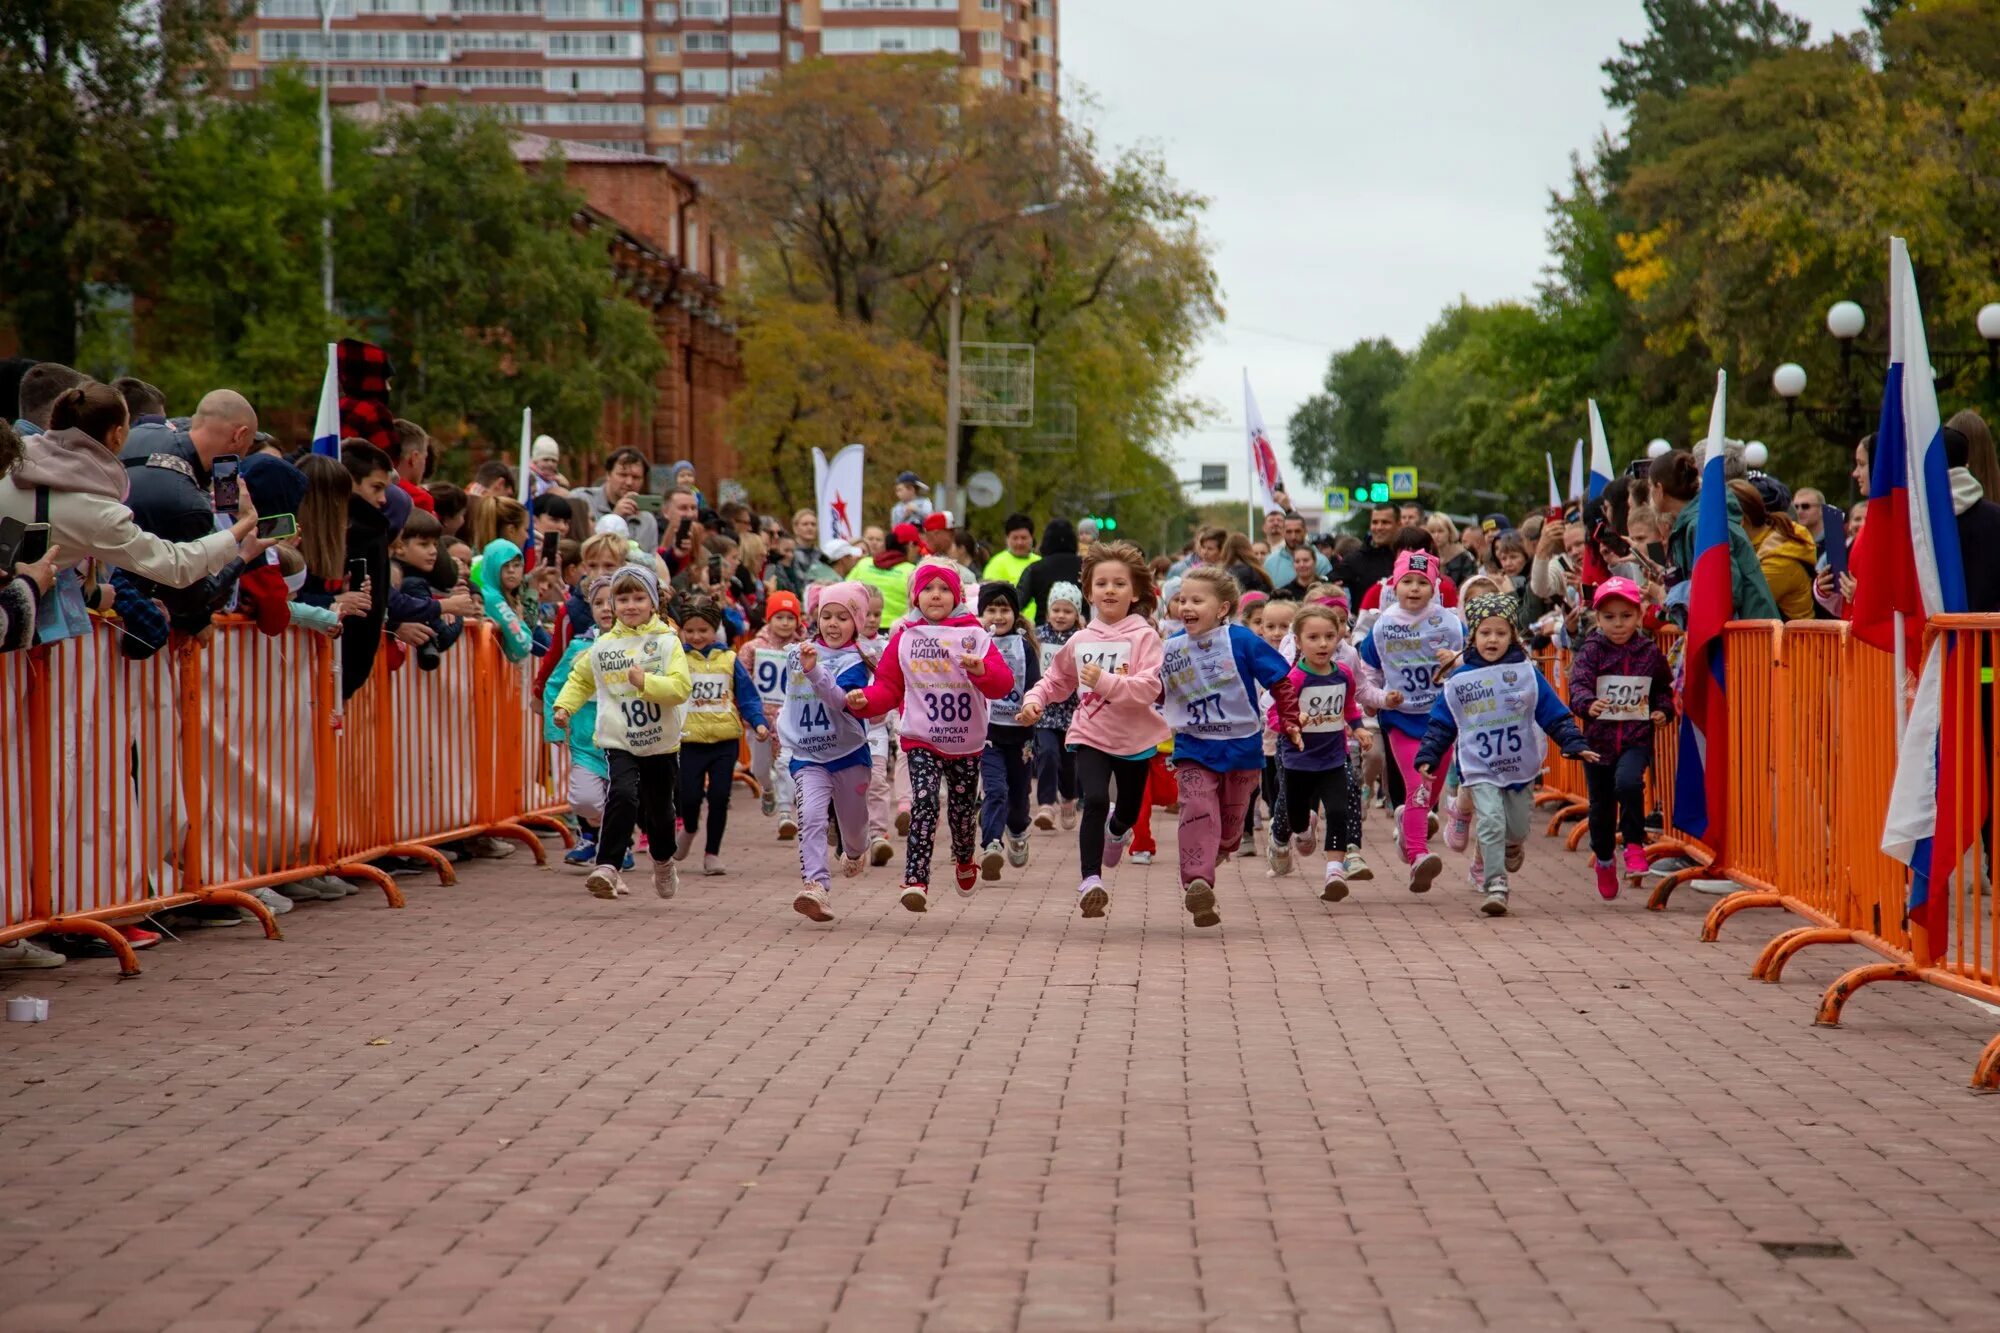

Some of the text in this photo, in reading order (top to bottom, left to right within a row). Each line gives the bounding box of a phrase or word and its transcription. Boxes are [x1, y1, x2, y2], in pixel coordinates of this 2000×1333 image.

[912, 638, 940, 647] КРОСС
[598, 650, 625, 661] КРОСС
[910, 649, 949, 659] НАЦИИ
[599, 658, 634, 671] НАЦИИ
[911, 660, 952, 673] 2022
[691, 682, 723, 699] 681
[1455, 680, 1483, 696] КРОСС
[1458, 687, 1494, 705] НАЦИИ
[1607, 685, 1643, 705] 595
[924, 692, 971, 722] 388
[1187, 693, 1226, 726] 377
[1309, 694, 1343, 717] 840
[621, 699, 661, 727] 180
[800, 703, 830, 732] 44
[626, 726, 663, 739] АМУРСКАЯ
[929, 726, 968, 734] АМУРСКАЯ
[1198, 724, 1231, 732] ОБЛАСТЬ
[630, 737, 661, 746] ОБЛАСТЬ
[798, 734, 837, 744] АМУРСКАЯ
[931, 735, 966, 743] ОБЛАСТЬ
[1476, 725, 1522, 758] 375
